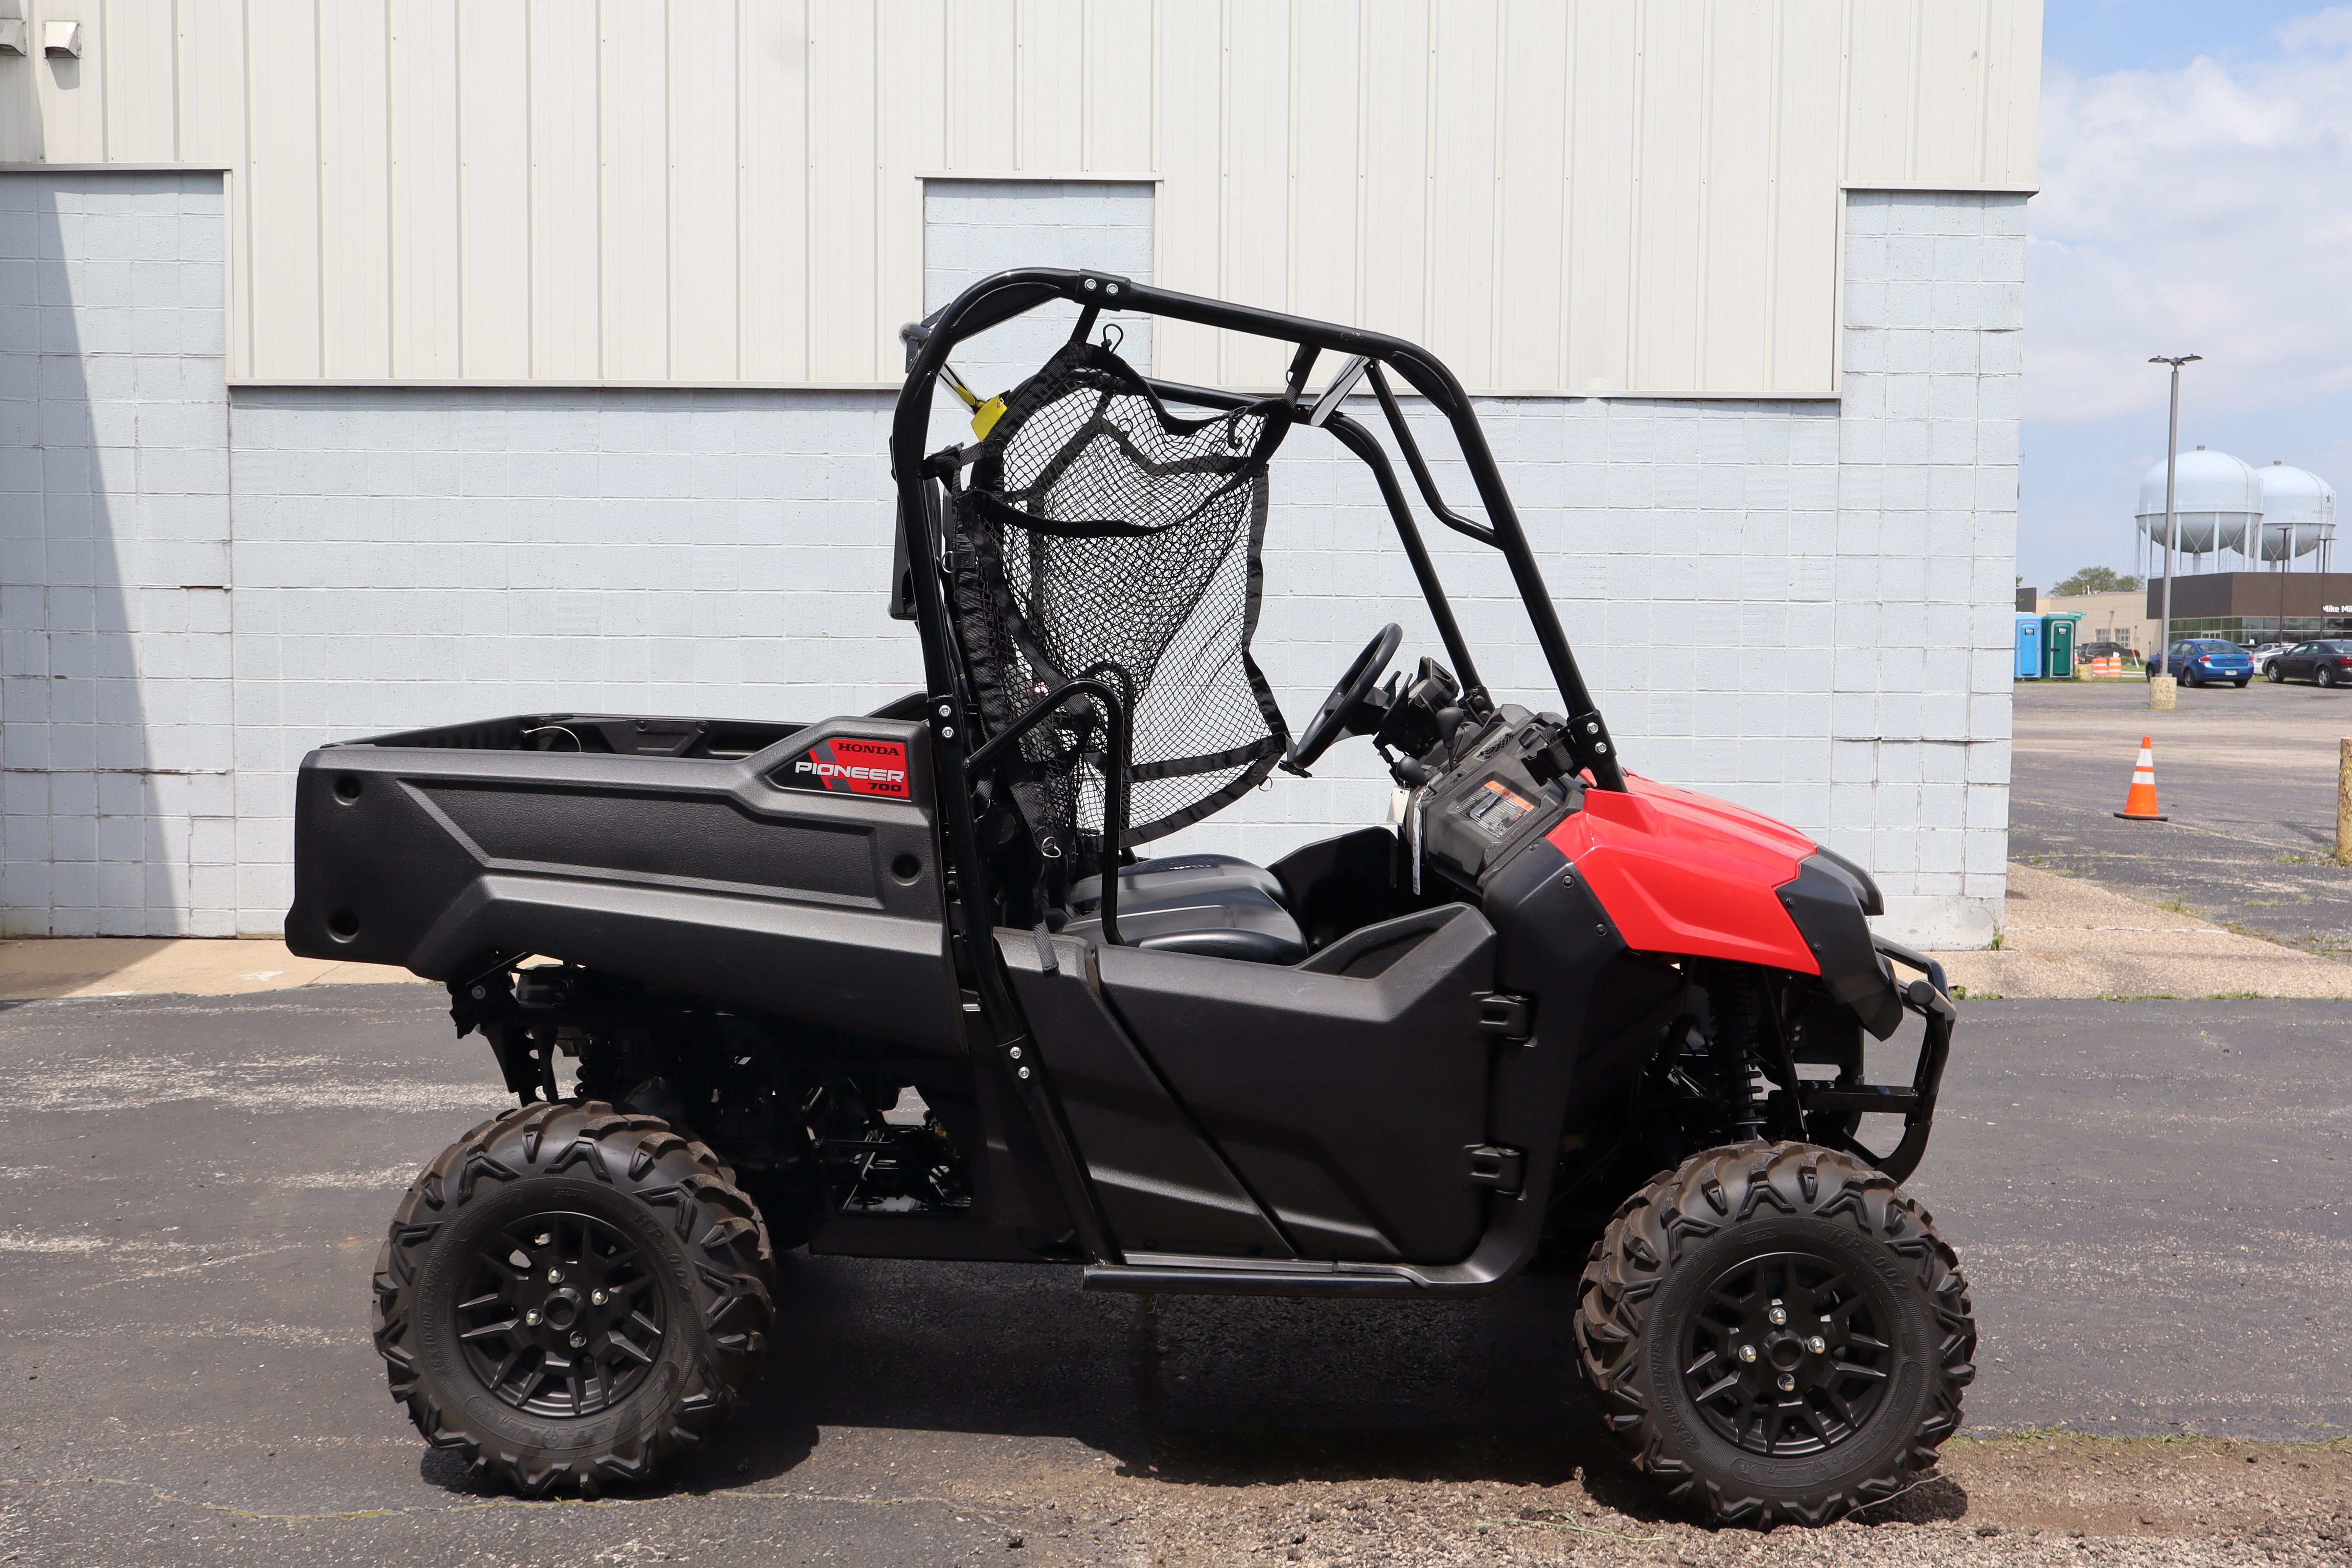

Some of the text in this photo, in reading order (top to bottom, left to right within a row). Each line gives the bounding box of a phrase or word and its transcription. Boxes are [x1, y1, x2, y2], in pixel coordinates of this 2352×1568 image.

[838, 743, 900, 755] HONDA
[795, 761, 904, 782] PIONEER
[867, 782, 901, 791] 700
[632, 1212, 693, 1295] HP-007
[1828, 1228, 1911, 1292] HP-007
